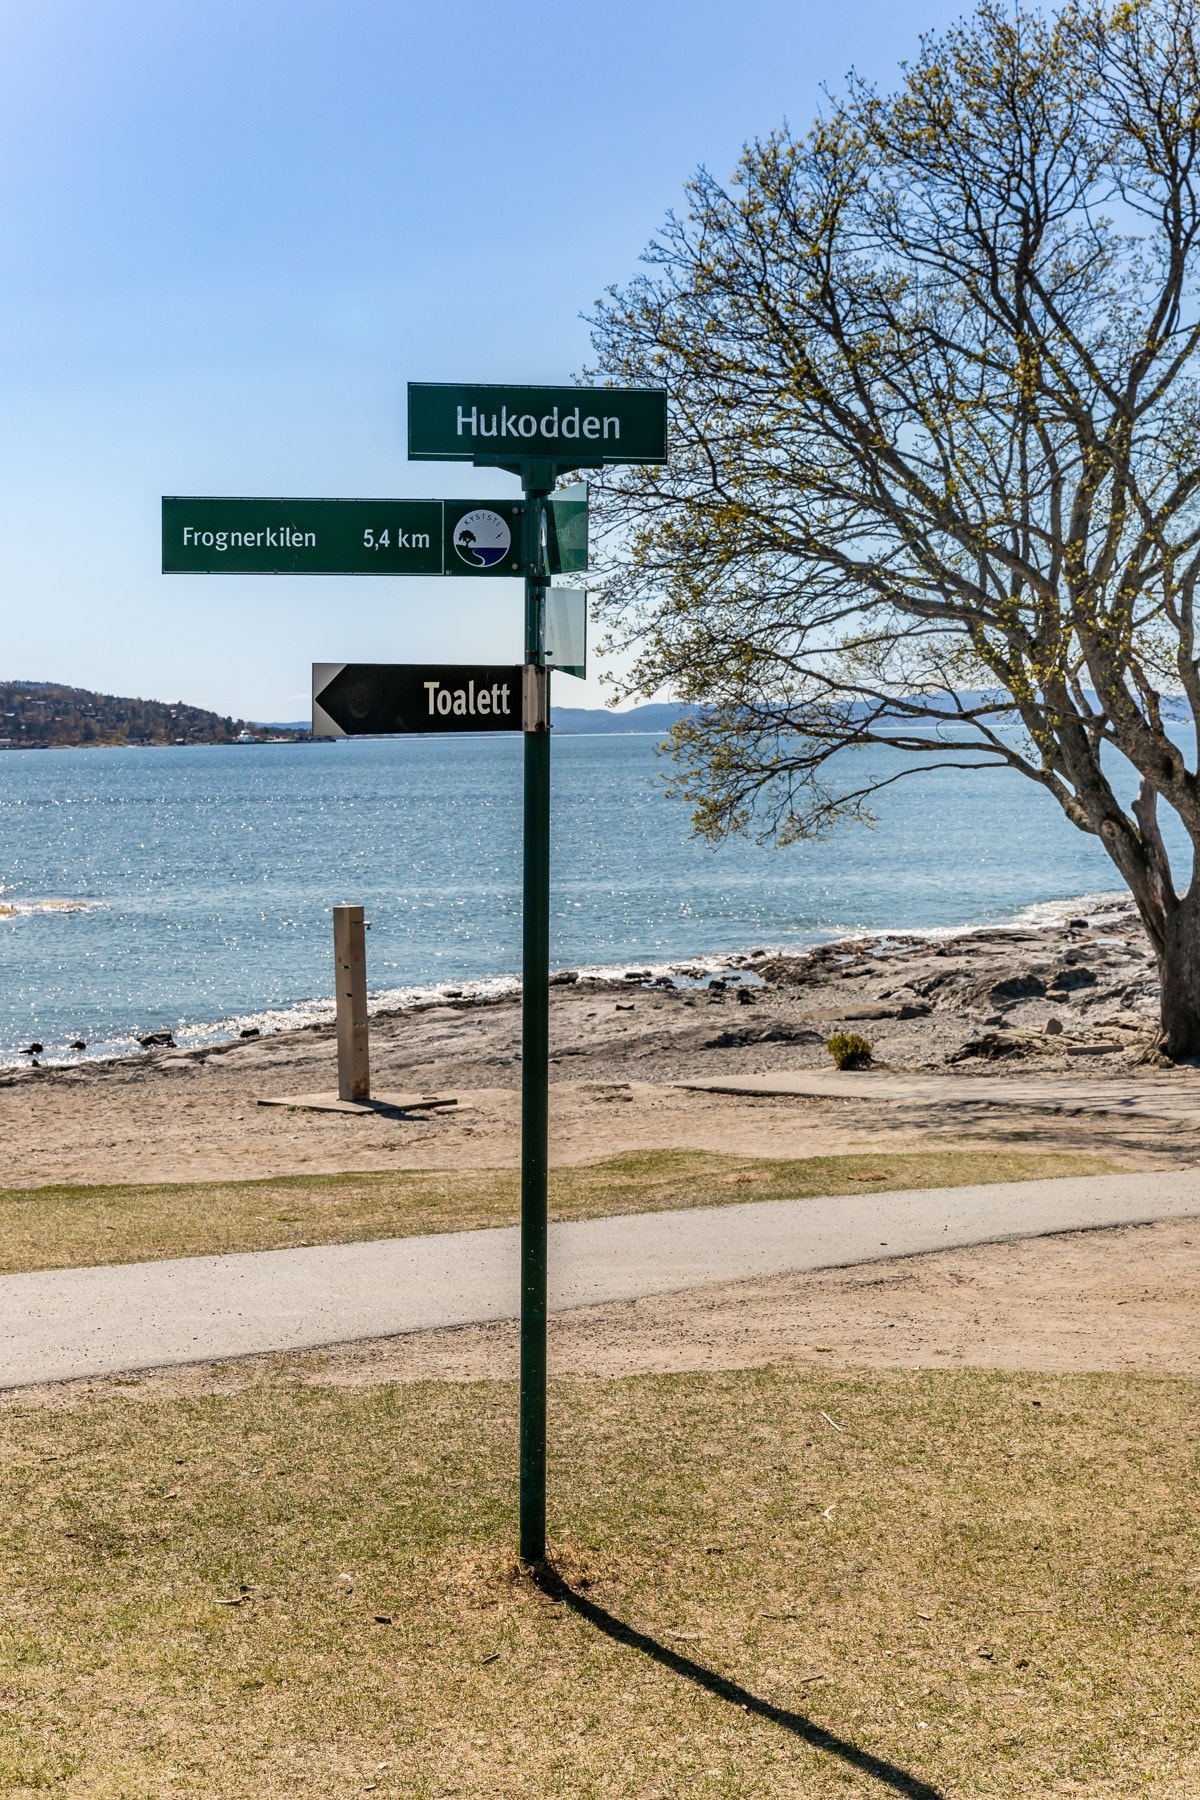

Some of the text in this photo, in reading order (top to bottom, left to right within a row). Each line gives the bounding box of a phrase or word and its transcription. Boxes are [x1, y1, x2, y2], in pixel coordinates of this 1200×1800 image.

[456, 405, 620, 439] Hukodden
[463, 513, 501, 526] KYSTSTI
[183, 526, 430, 551] Frognerkilen 5,4 km
[423, 680, 511, 716] Toalett
